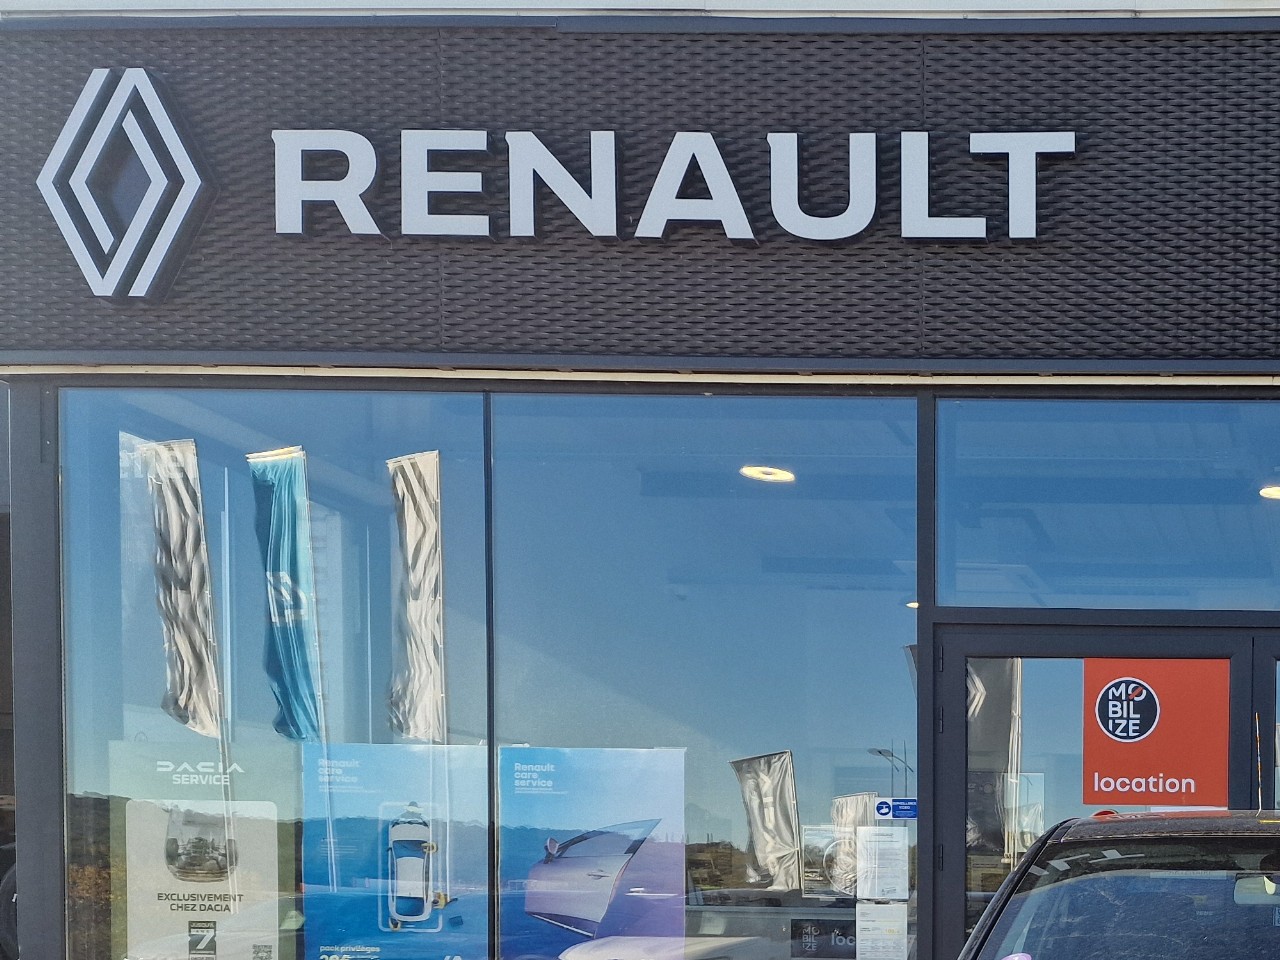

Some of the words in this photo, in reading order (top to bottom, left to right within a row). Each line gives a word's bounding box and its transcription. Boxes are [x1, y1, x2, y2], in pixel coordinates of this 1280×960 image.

[271, 129, 1075, 239] RENAULT
[156, 761, 245, 773] DACIA
[514, 763, 555, 772] Renault
[172, 774, 230, 785] SERVICE
[514, 778, 553, 787] service
[1094, 772, 1195, 793] location
[157, 892, 244, 902] EXCLUSIVEMENT
[170, 903, 197, 911] CHEZ
[199, 904, 231, 912] DACIA
[831, 932, 855, 946] loc
